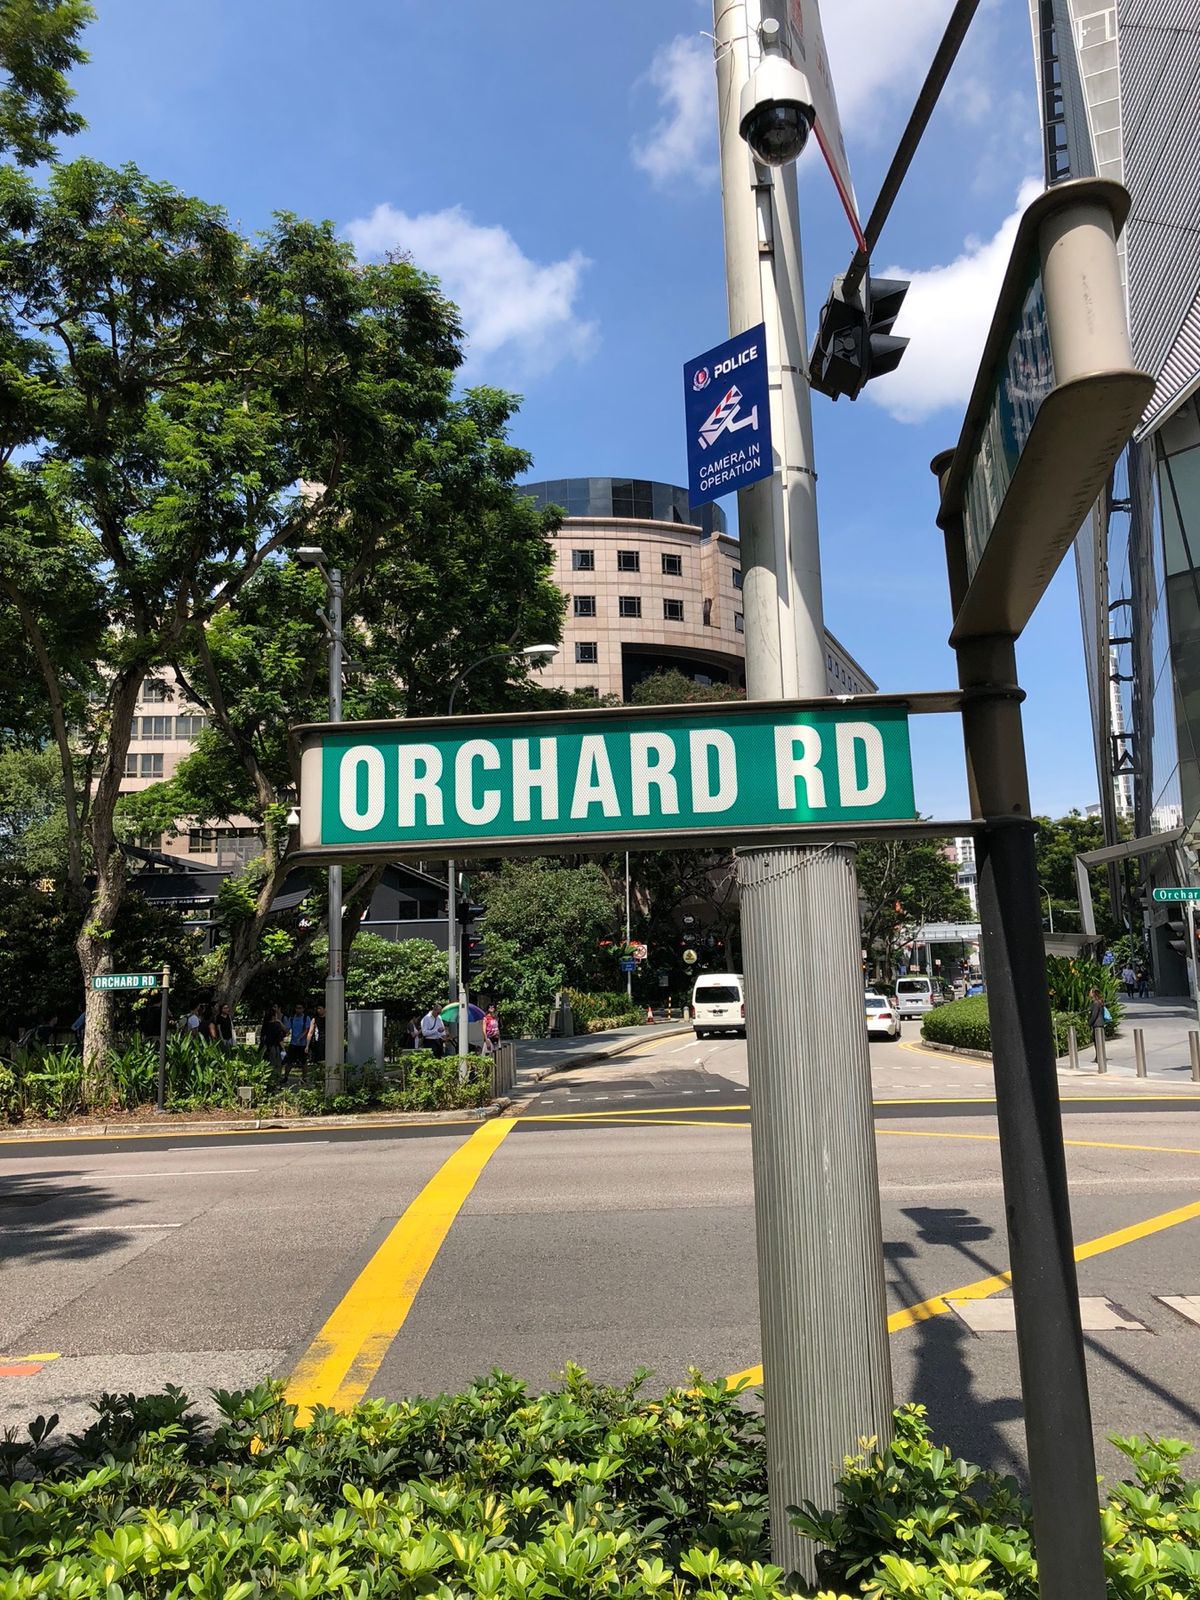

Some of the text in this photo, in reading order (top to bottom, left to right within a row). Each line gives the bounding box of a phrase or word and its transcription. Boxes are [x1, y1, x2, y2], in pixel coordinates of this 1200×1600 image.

[714, 346, 758, 379] POLICE
[699, 442, 760, 478] CAMERA IN
[700, 456, 761, 492] OPERATION
[338, 721, 887, 832] ORCHARD RD
[1160, 890, 1198, 900] Orchar
[96, 975, 155, 988] ORCHARD RD
